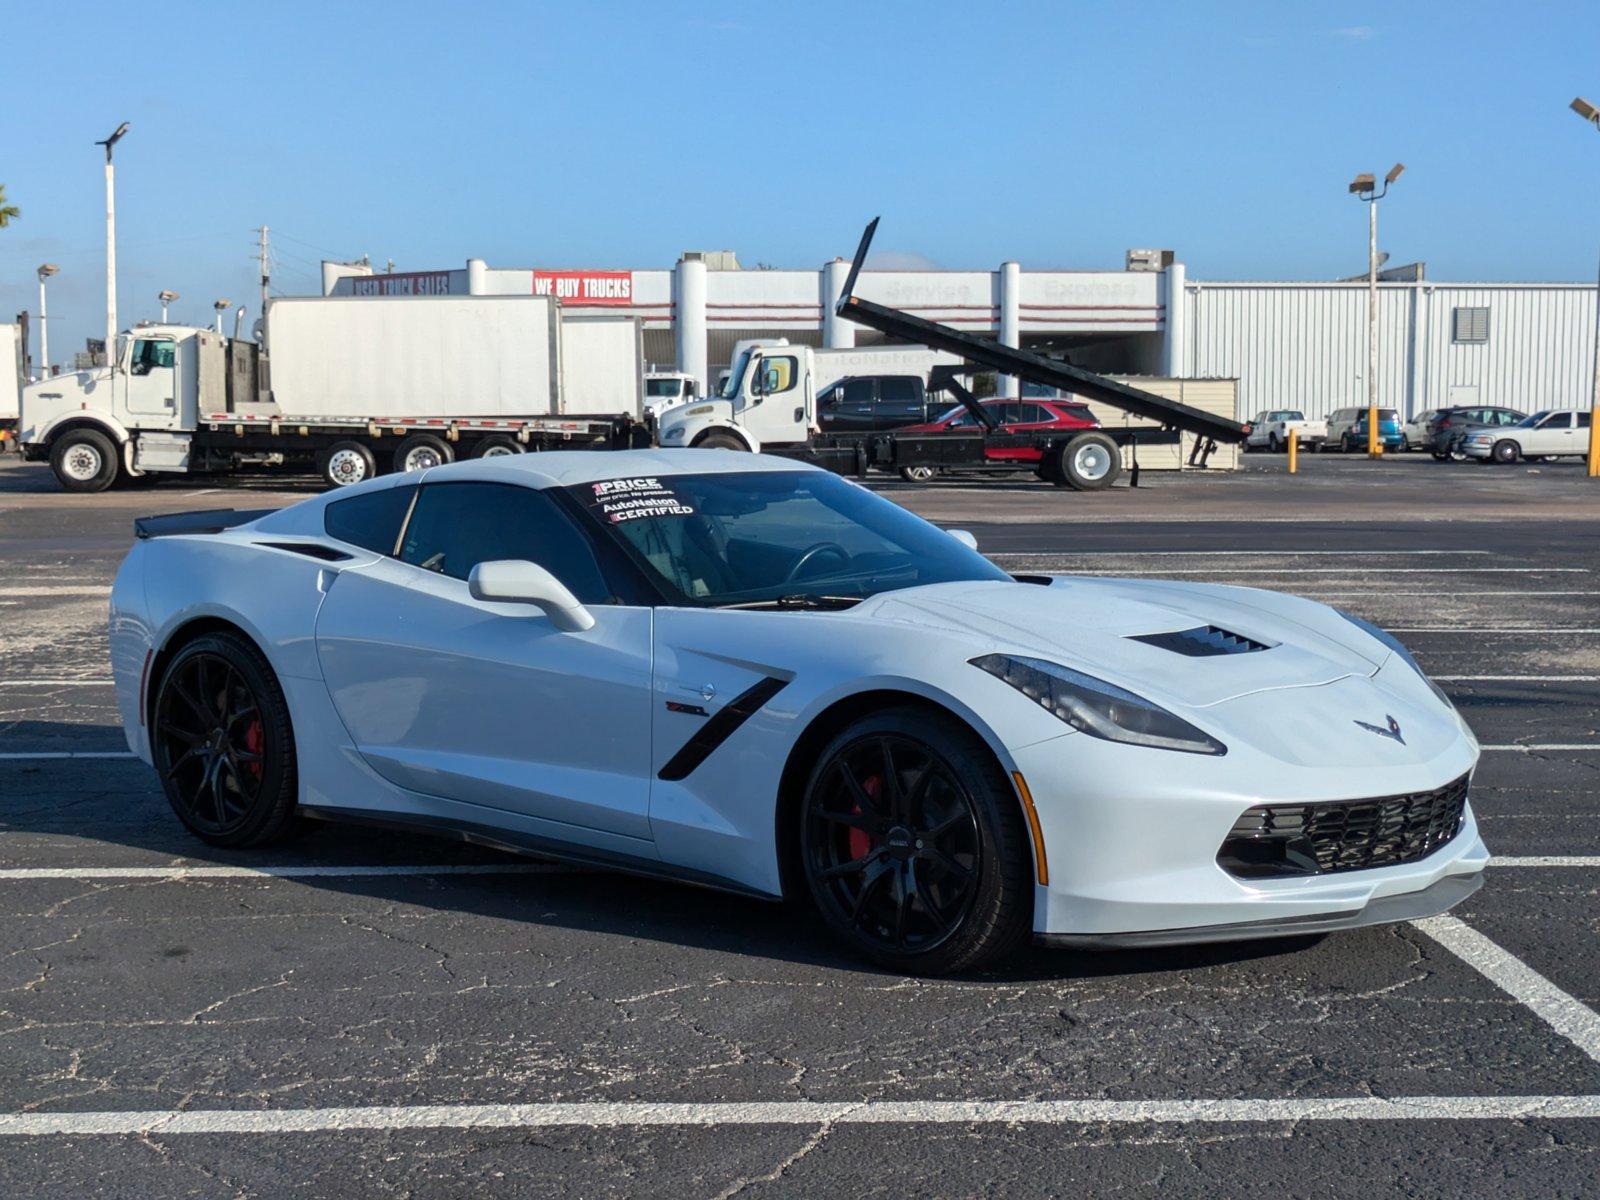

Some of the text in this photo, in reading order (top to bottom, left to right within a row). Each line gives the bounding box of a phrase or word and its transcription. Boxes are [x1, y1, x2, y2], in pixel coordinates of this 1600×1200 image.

[383, 277, 414, 296] TRUCK
[417, 275, 448, 295] SALES
[534, 278, 631, 297] WE BUY TRUCKS
[603, 498, 678, 513] AutoNation
[615, 506, 693, 520] CERTIFIED
